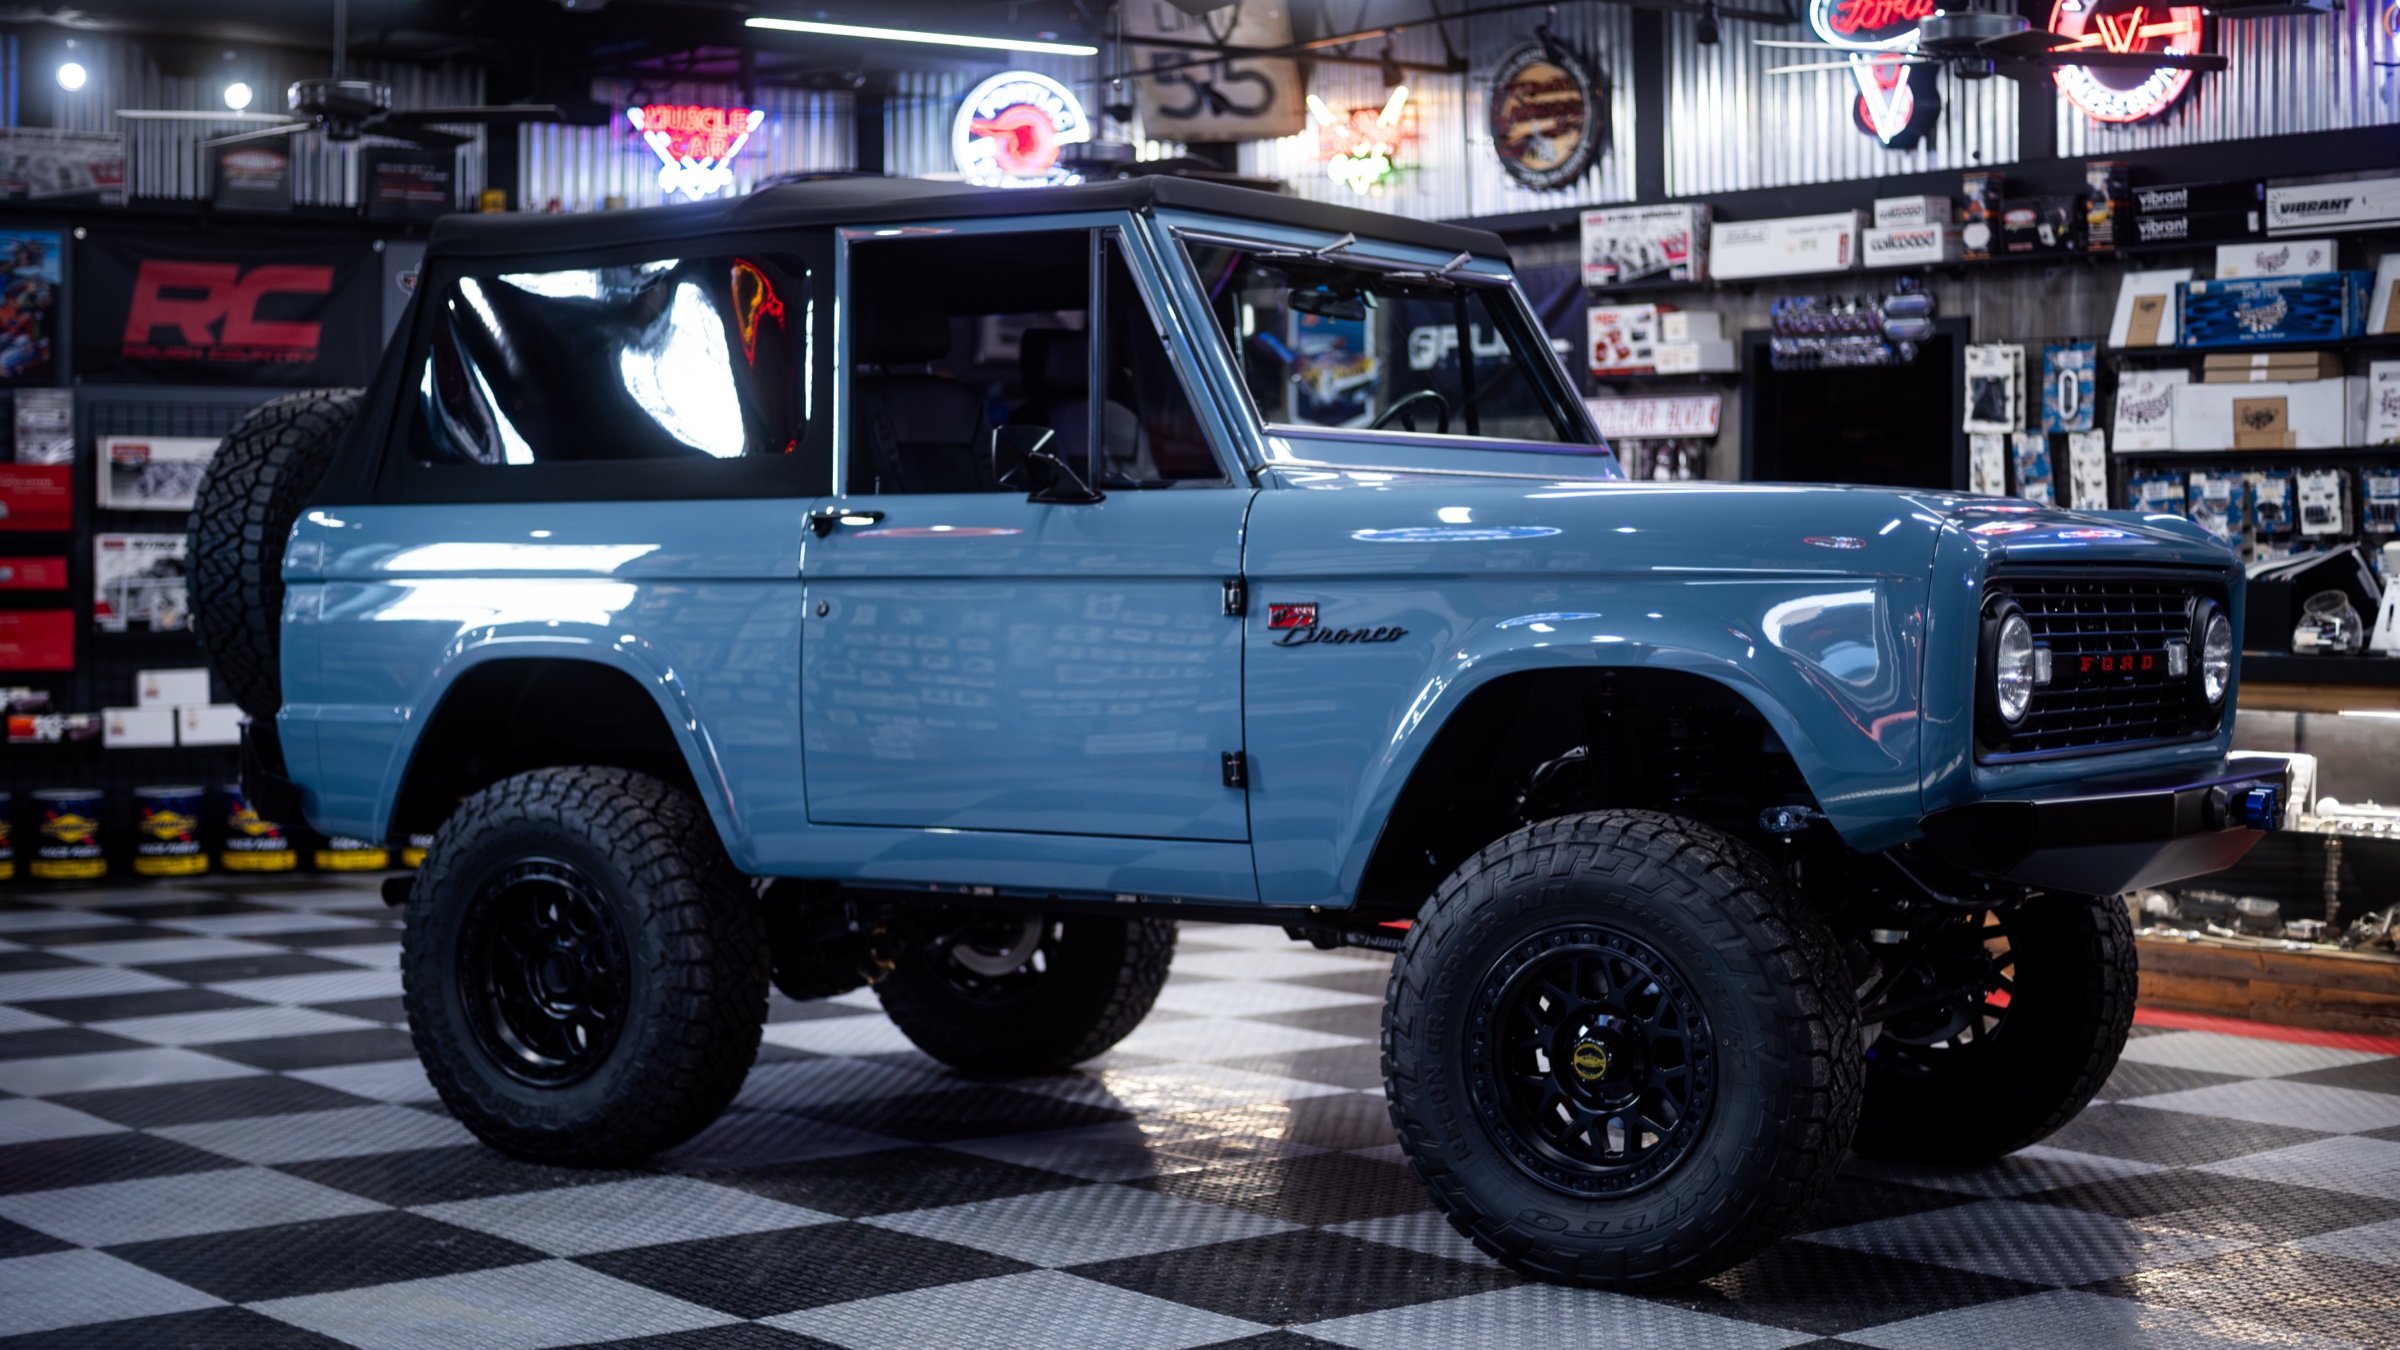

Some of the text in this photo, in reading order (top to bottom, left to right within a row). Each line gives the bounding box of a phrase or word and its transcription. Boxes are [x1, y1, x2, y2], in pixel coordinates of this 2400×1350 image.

[642, 105, 750, 135] MUSCLE
[669, 133, 730, 160] CAR
[2138, 187, 2188, 205] vibrant
[2280, 198, 2354, 214] VIBRANT
[2138, 218, 2188, 236] vibrant
[121, 260, 335, 348] RC
[1272, 614, 1409, 647] Bronco
[2080, 655, 2153, 672] FORD
[1512, 1152, 1722, 1240] NITTO
